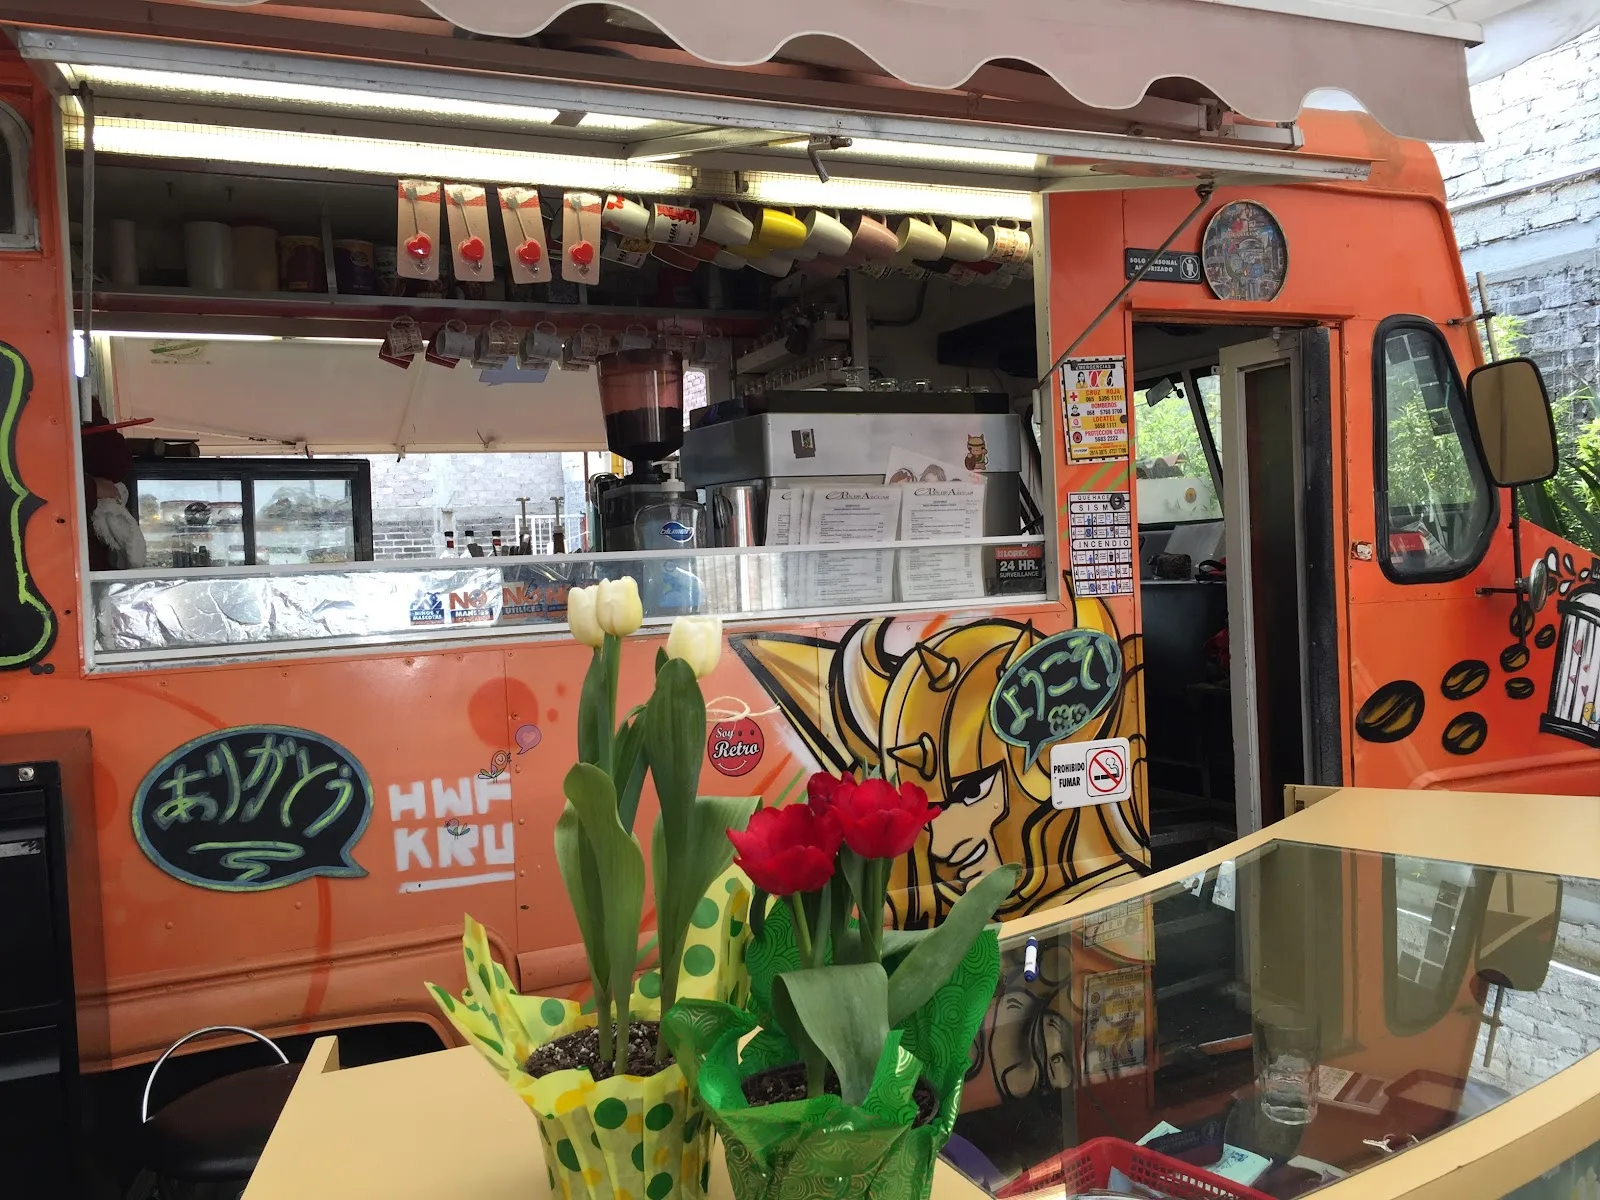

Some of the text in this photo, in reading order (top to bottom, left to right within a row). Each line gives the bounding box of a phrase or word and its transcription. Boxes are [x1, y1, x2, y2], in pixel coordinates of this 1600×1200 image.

[1004, 550, 1028, 558] LOREX
[1000, 560, 1038, 572] 24 HR.
[505, 606, 540, 614] UTILICES
[716, 727, 734, 740] Soy
[713, 741, 760, 759] Retro
[1053, 762, 1085, 774] PROHIBIDO
[1058, 776, 1080, 788] FUMAR
[394, 822, 515, 872] KRU
